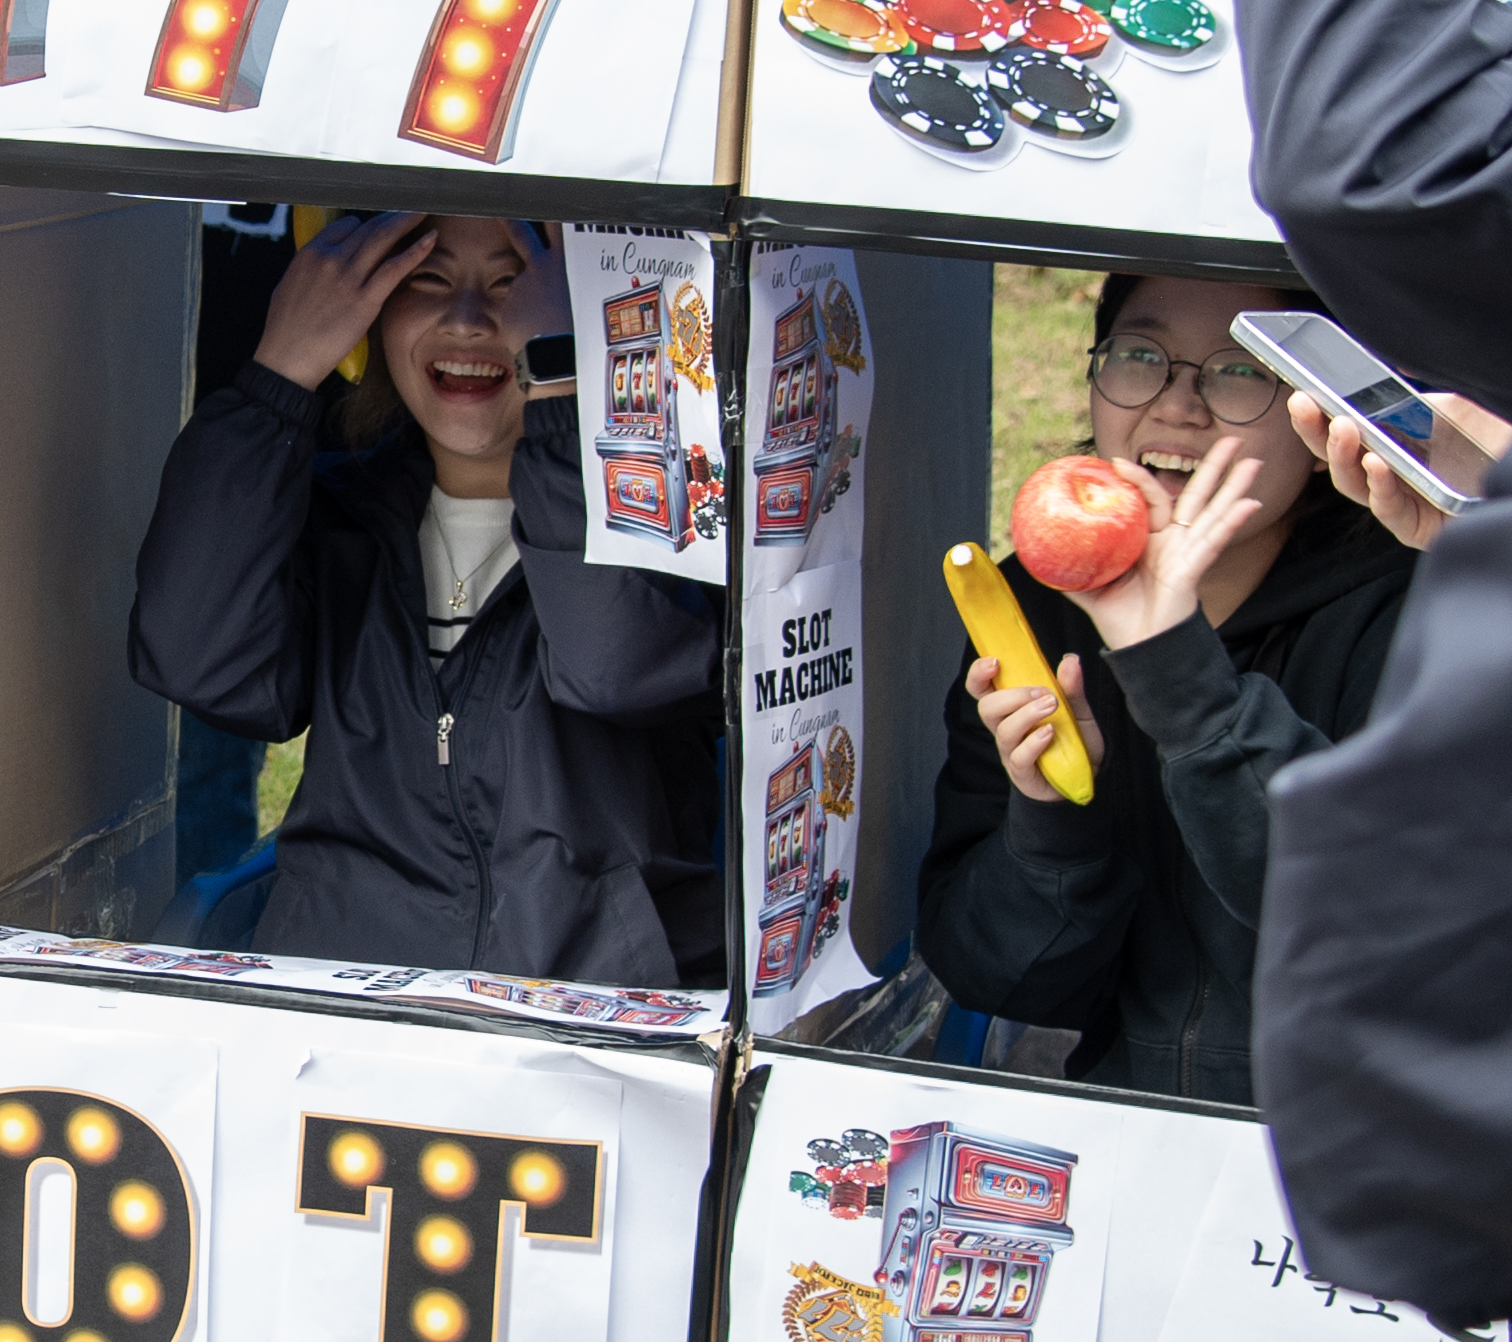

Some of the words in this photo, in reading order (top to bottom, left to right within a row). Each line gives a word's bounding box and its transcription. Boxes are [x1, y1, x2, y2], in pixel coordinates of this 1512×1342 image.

[600, 247, 619, 272] in
[782, 608, 832, 659] SLOT
[754, 647, 853, 712] MACHINE
